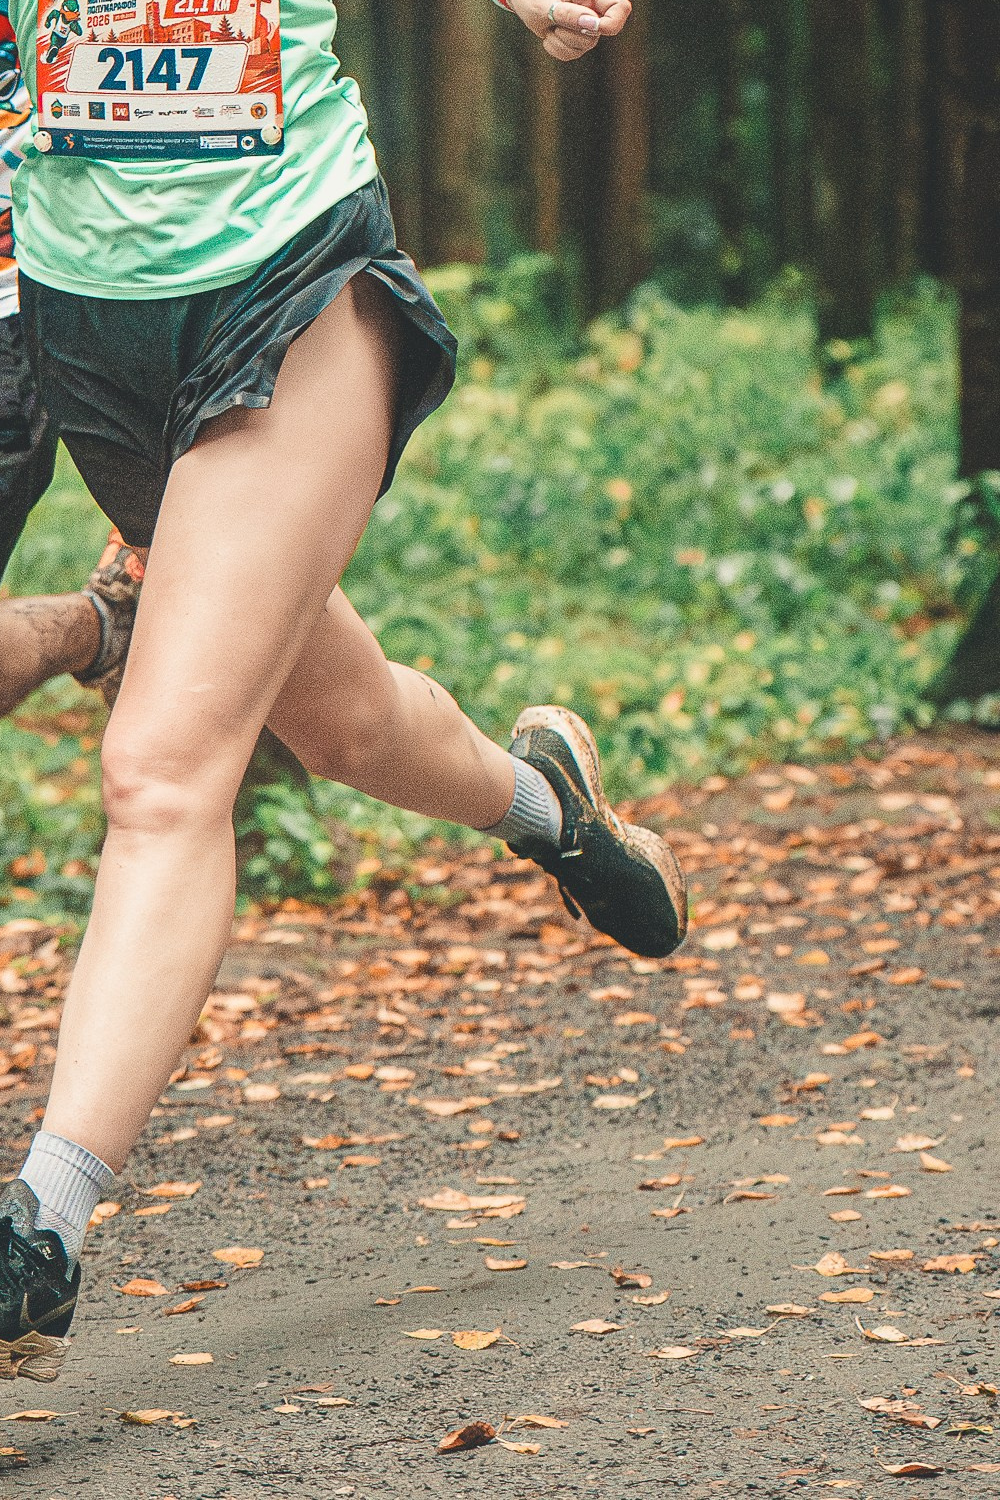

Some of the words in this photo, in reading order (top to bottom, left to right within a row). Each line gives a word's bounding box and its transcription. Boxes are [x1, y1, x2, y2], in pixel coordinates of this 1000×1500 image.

[87, 0, 137, 15] ПОЛУМАРАФОН
[87, 13, 110, 28] 2026
[97, 47, 213, 91] 2147
